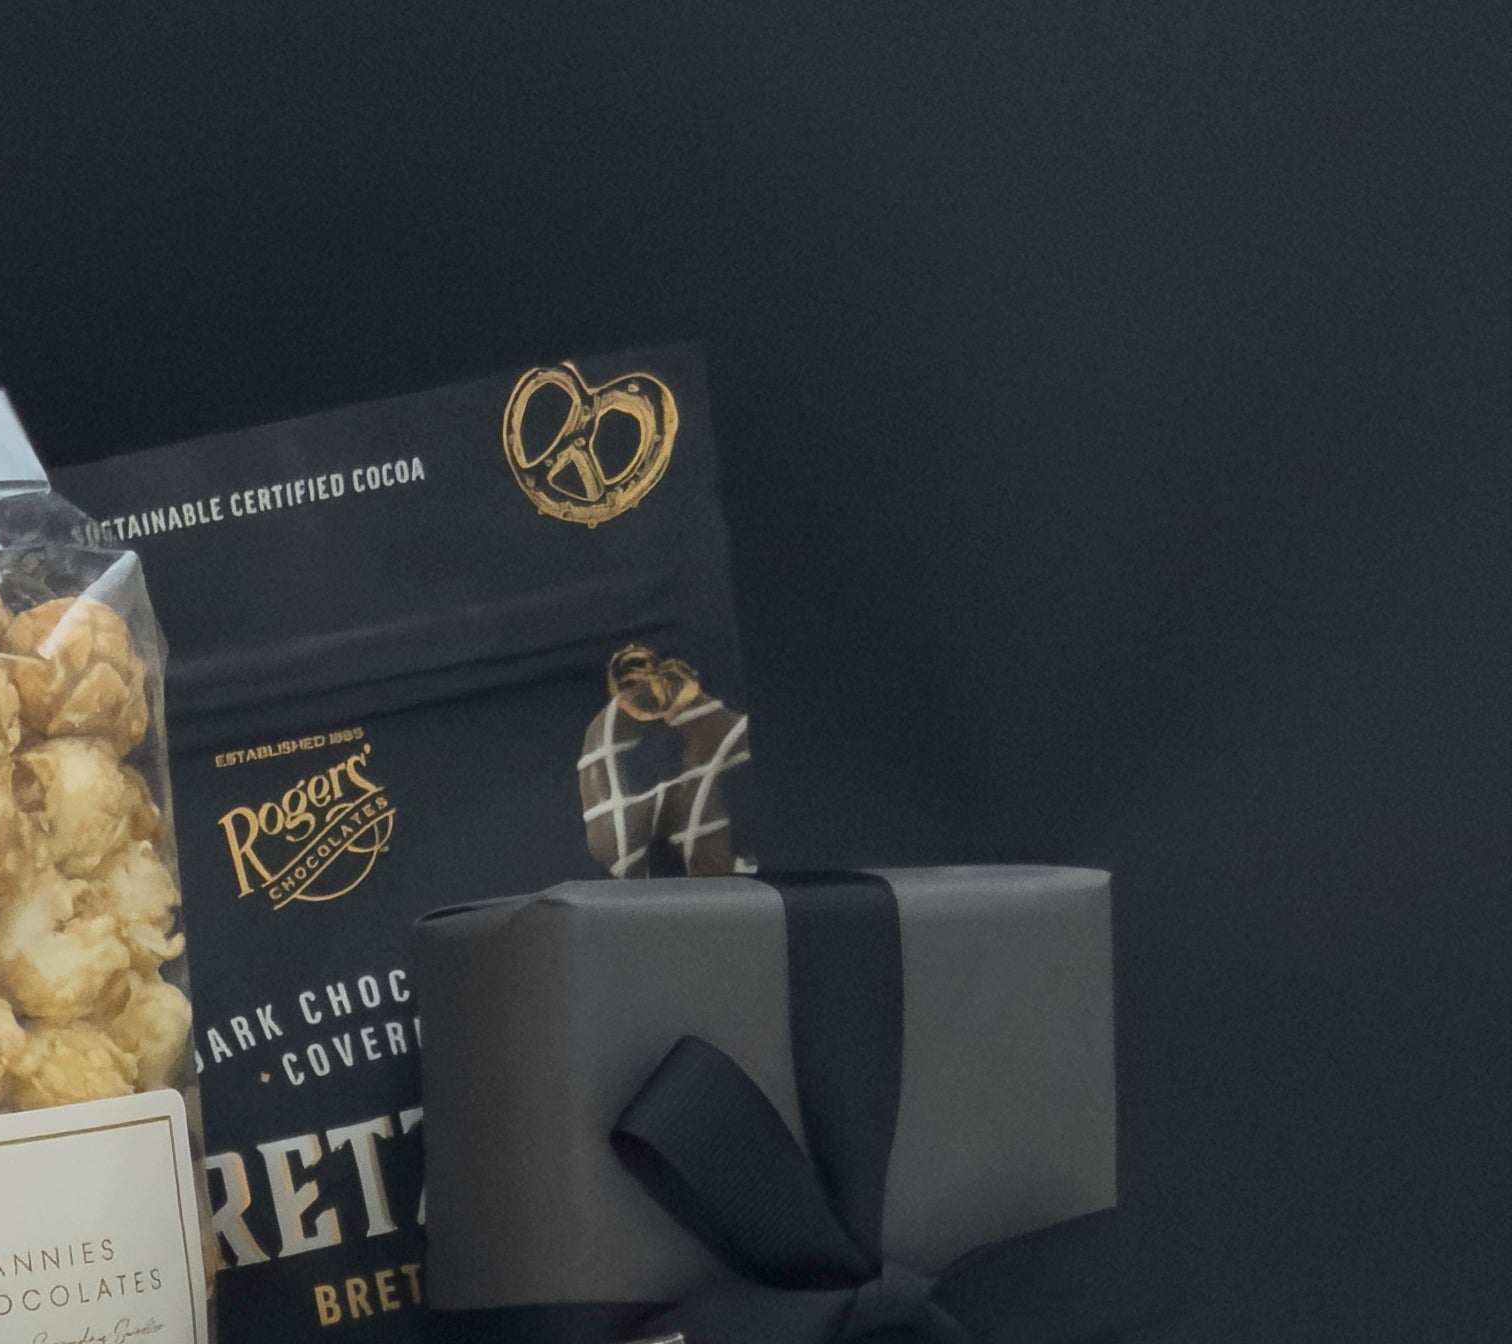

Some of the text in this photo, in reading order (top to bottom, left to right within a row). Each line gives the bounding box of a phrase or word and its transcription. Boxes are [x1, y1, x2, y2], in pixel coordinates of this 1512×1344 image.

[230, 473, 345, 517] CERTIFIED
[352, 456, 425, 493] COCOA
[215, 735, 325, 768] ESTABLISHED
[268, 796, 389, 901] CHOCOLATES
[282, 1016, 424, 1086] COVER
